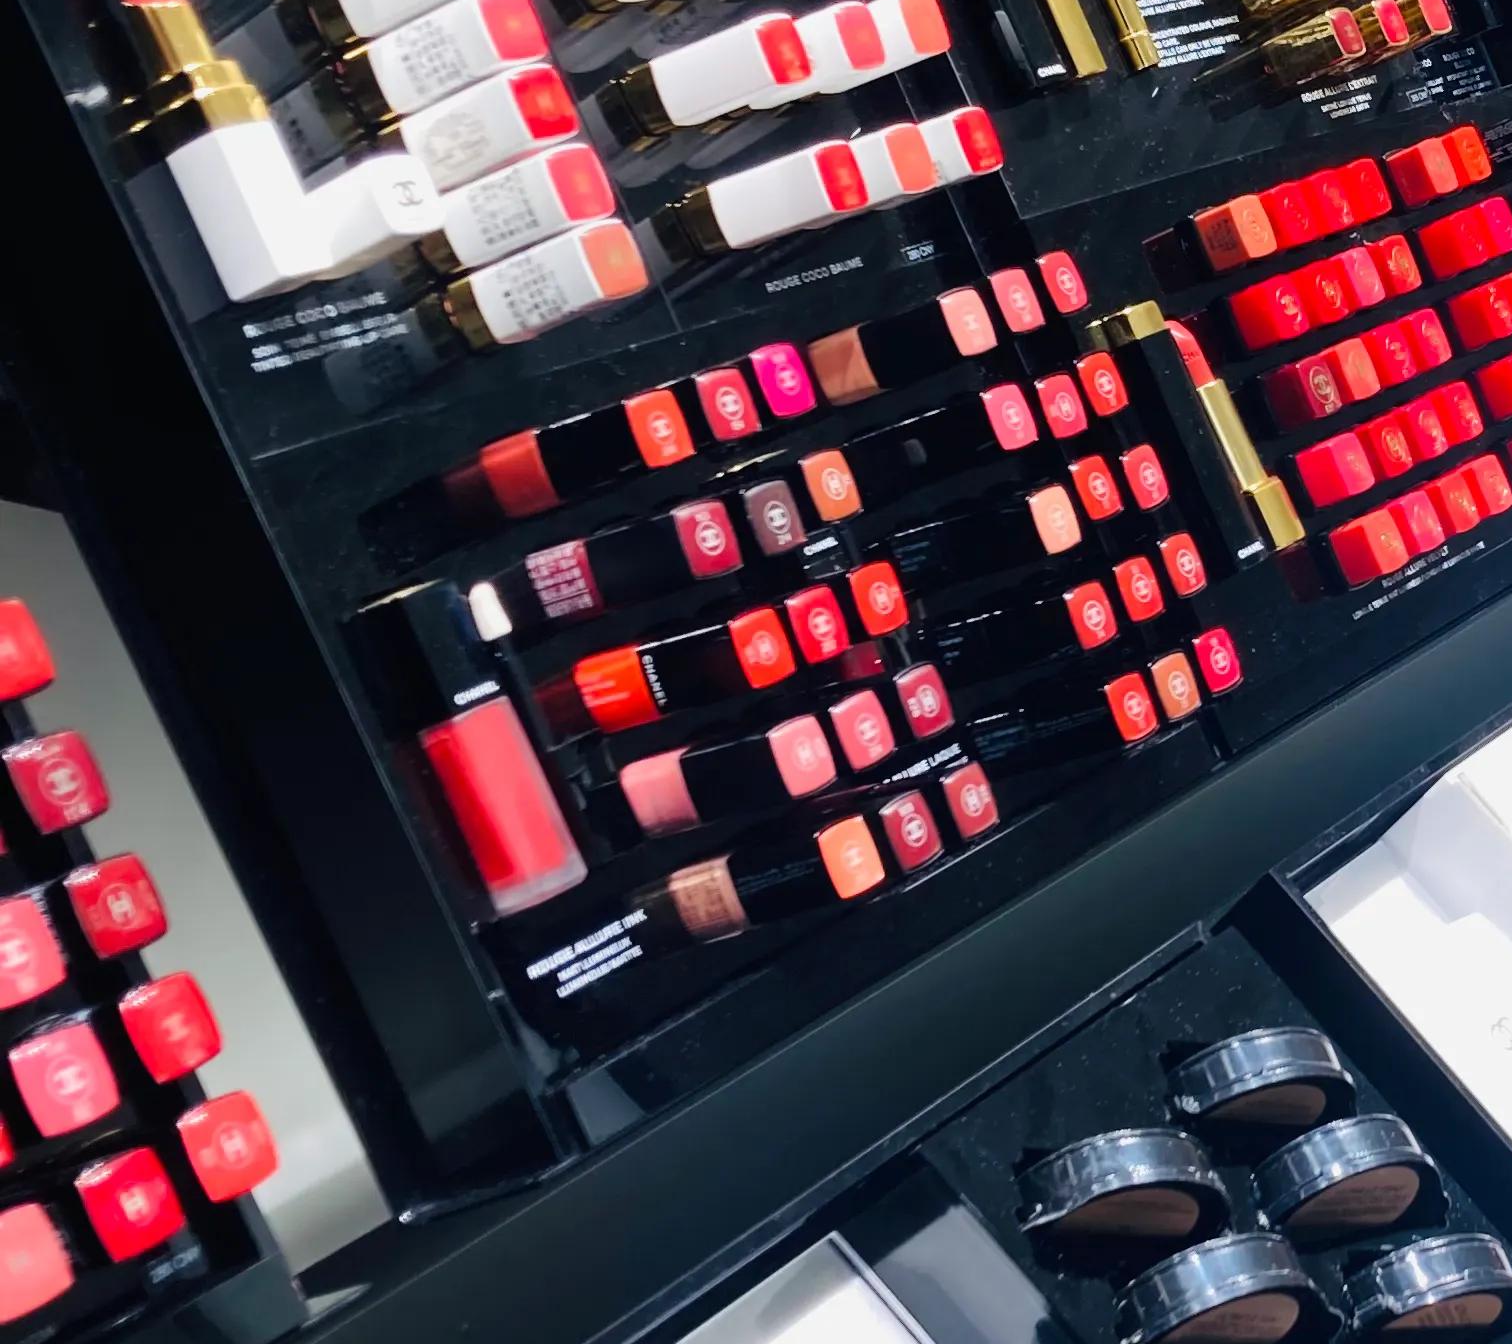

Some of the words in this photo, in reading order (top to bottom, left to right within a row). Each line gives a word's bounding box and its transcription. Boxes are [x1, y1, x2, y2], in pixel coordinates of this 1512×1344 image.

[765, 274, 802, 293] ROUGE
[801, 267, 830, 283] COCO
[828, 256, 864, 275] BAUME
[453, 680, 500, 706] CHANEL
[641, 655, 668, 707] CHANEL
[573, 920, 625, 954] ALLURE
